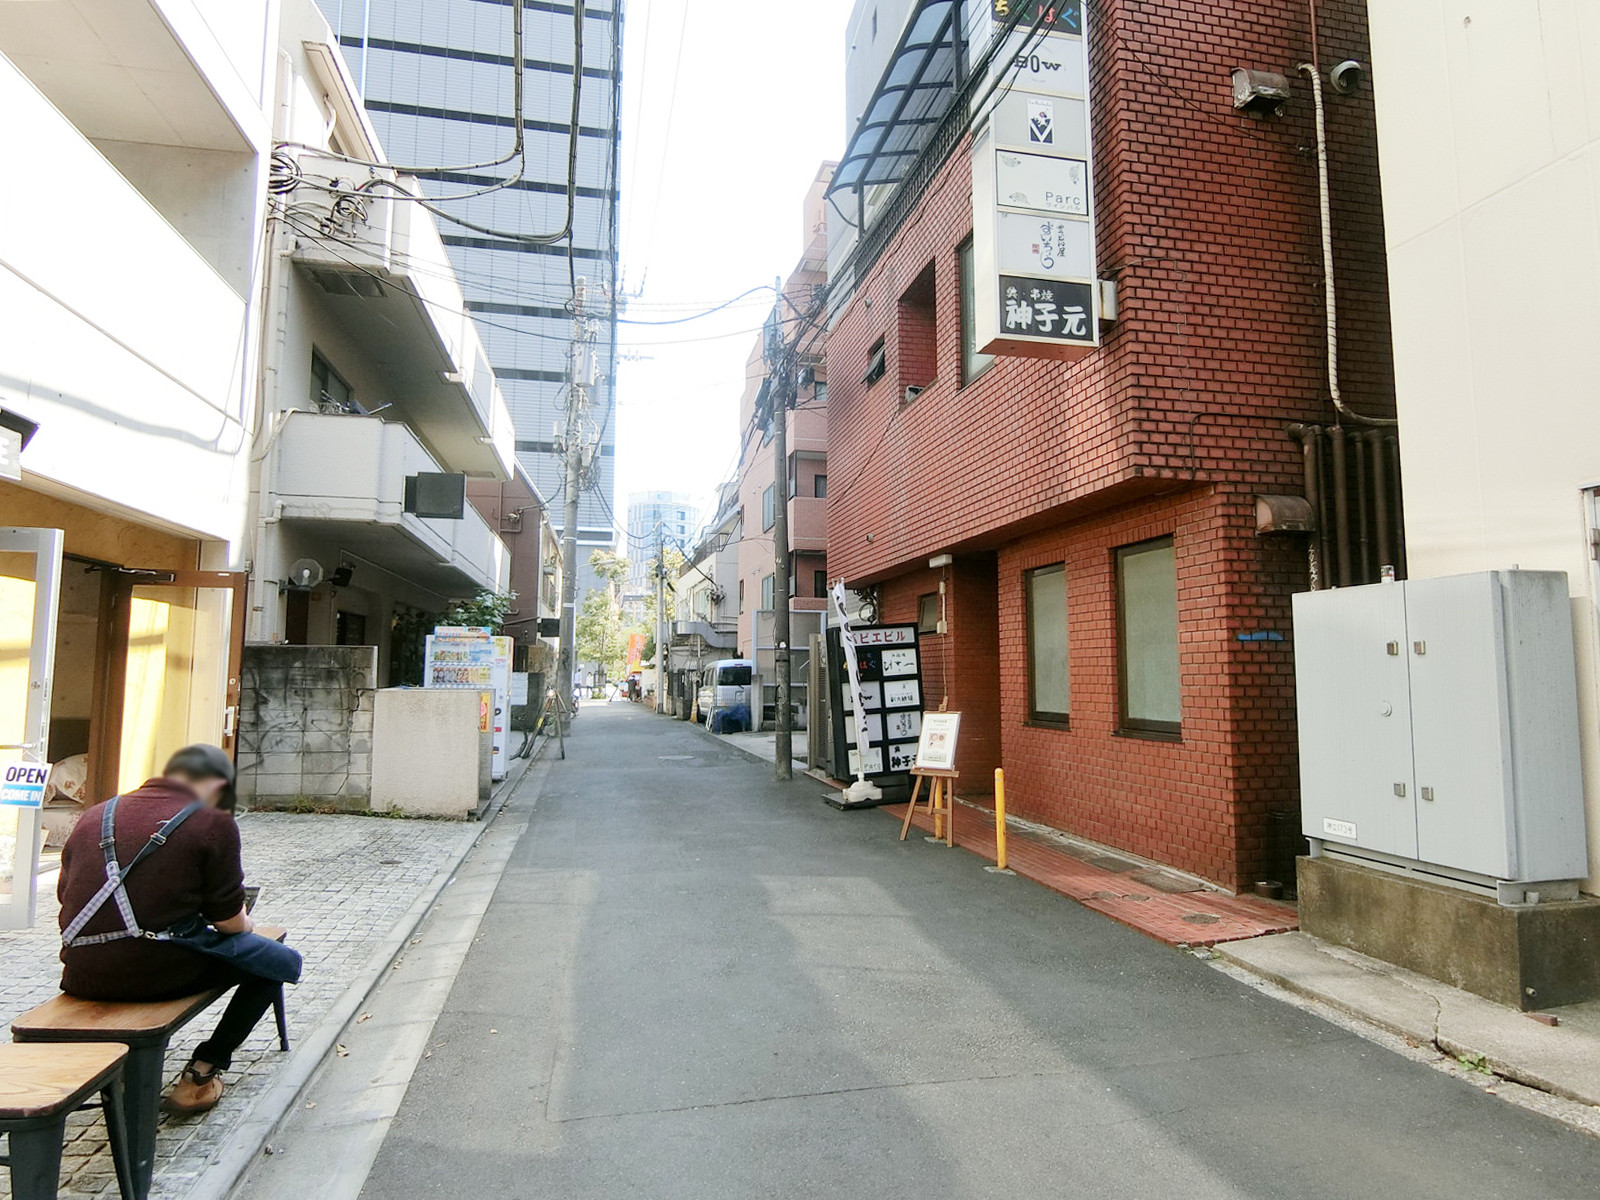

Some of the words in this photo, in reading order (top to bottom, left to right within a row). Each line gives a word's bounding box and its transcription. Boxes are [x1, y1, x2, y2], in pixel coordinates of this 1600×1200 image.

[994, 0, 1080, 28] ちはぐ
[1045, 191, 1081, 206] Parc
[1005, 299, 1087, 336] 神子元
[5, 766, 48, 784] OPEN
